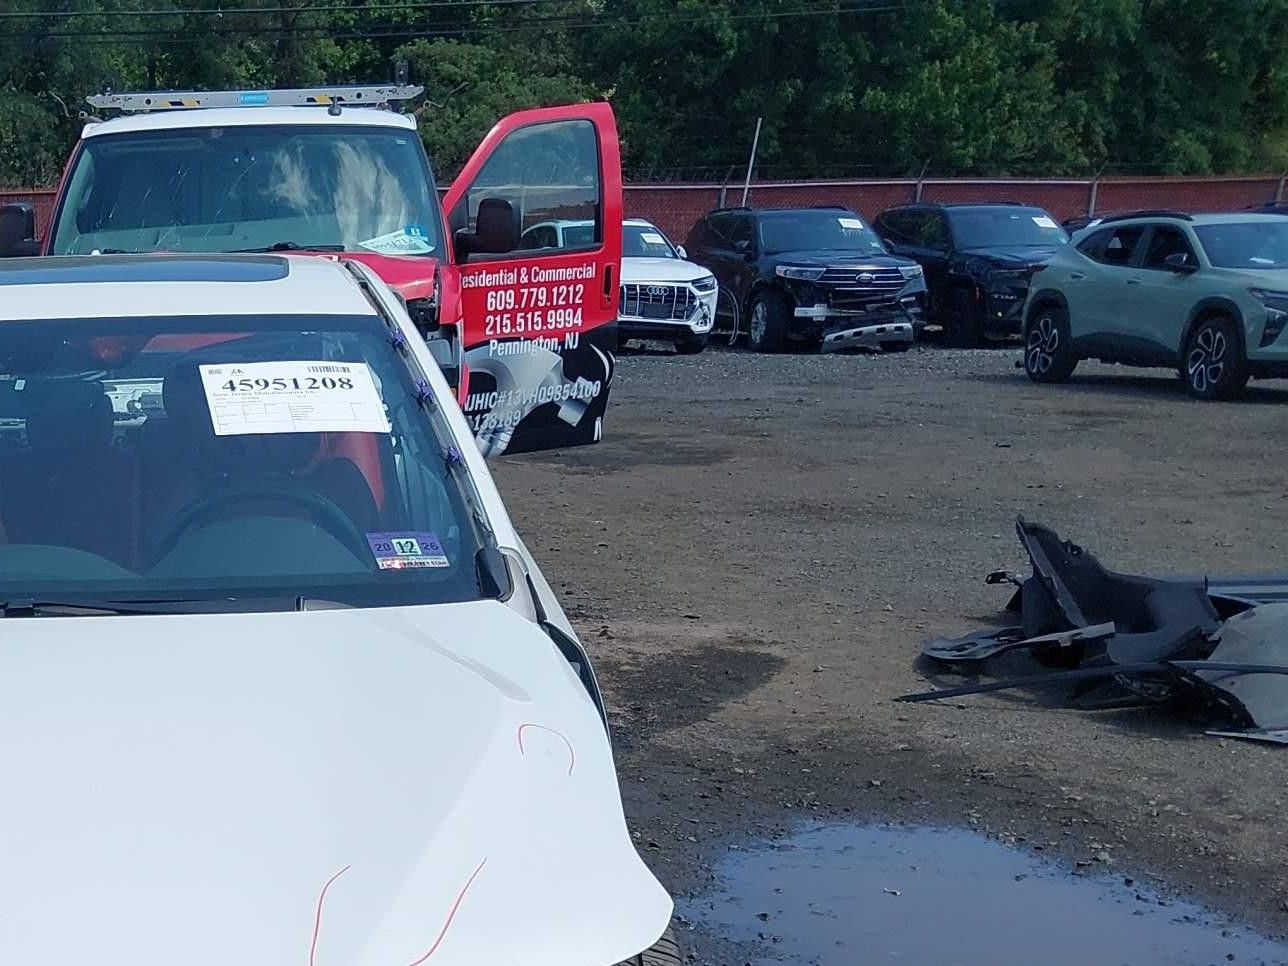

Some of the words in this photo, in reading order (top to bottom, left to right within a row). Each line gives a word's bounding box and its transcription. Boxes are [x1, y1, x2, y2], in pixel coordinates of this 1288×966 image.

[462, 267, 517, 288] esidential
[519, 267, 529, 284] &
[531, 262, 596, 283] Commercial
[487, 284, 584, 311] 609.779.1212
[485, 308, 583, 335] 215.515.9994
[489, 335, 562, 357] Pennington,
[564, 332, 579, 350] NJ
[222, 376, 354, 392] 45951208
[469, 410, 521, 431] 138189
[374, 543, 391, 552] 20
[396, 540, 418, 554] 12
[421, 542, 439, 551] 26
